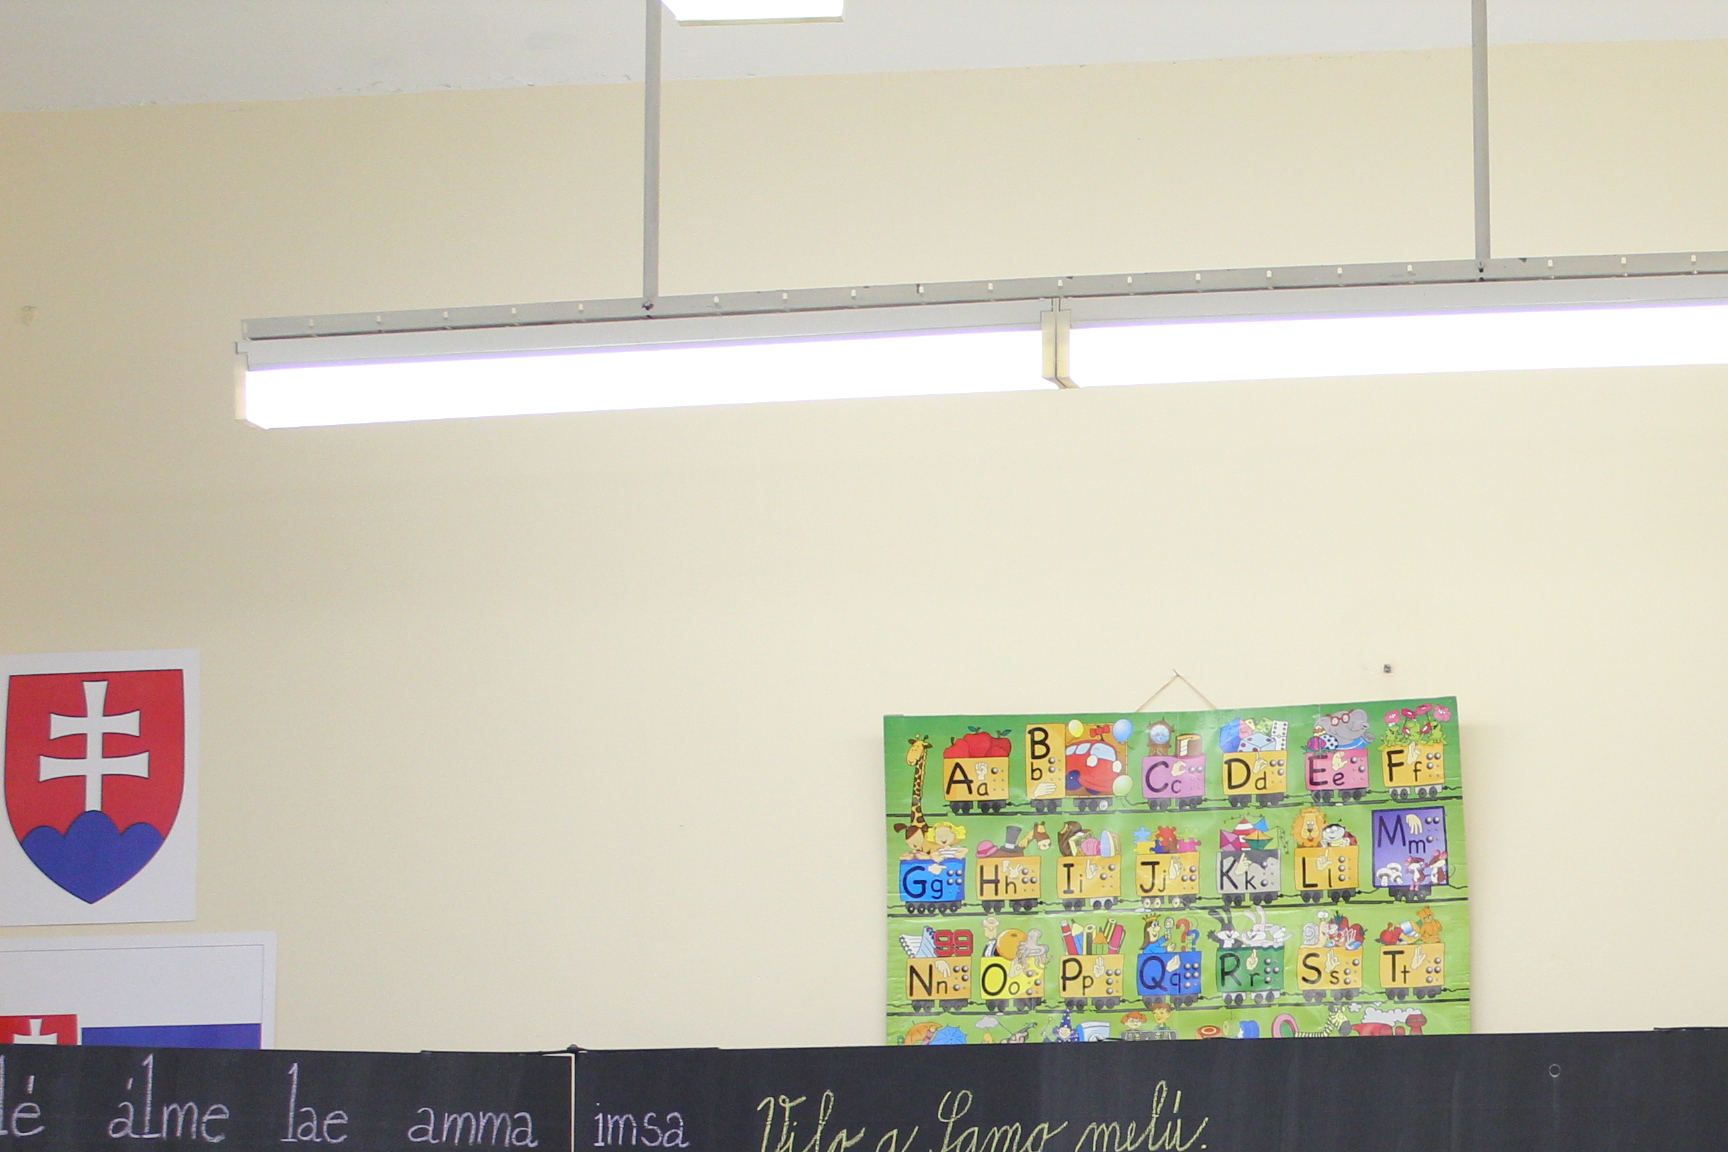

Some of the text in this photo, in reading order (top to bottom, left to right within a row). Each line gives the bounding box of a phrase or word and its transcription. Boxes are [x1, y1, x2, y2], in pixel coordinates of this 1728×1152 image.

[109, 1054, 229, 1143] álme
[281, 1063, 348, 1143] lae
[408, 1108, 538, 1147] amma
[594, 1103, 689, 1147] imsa
